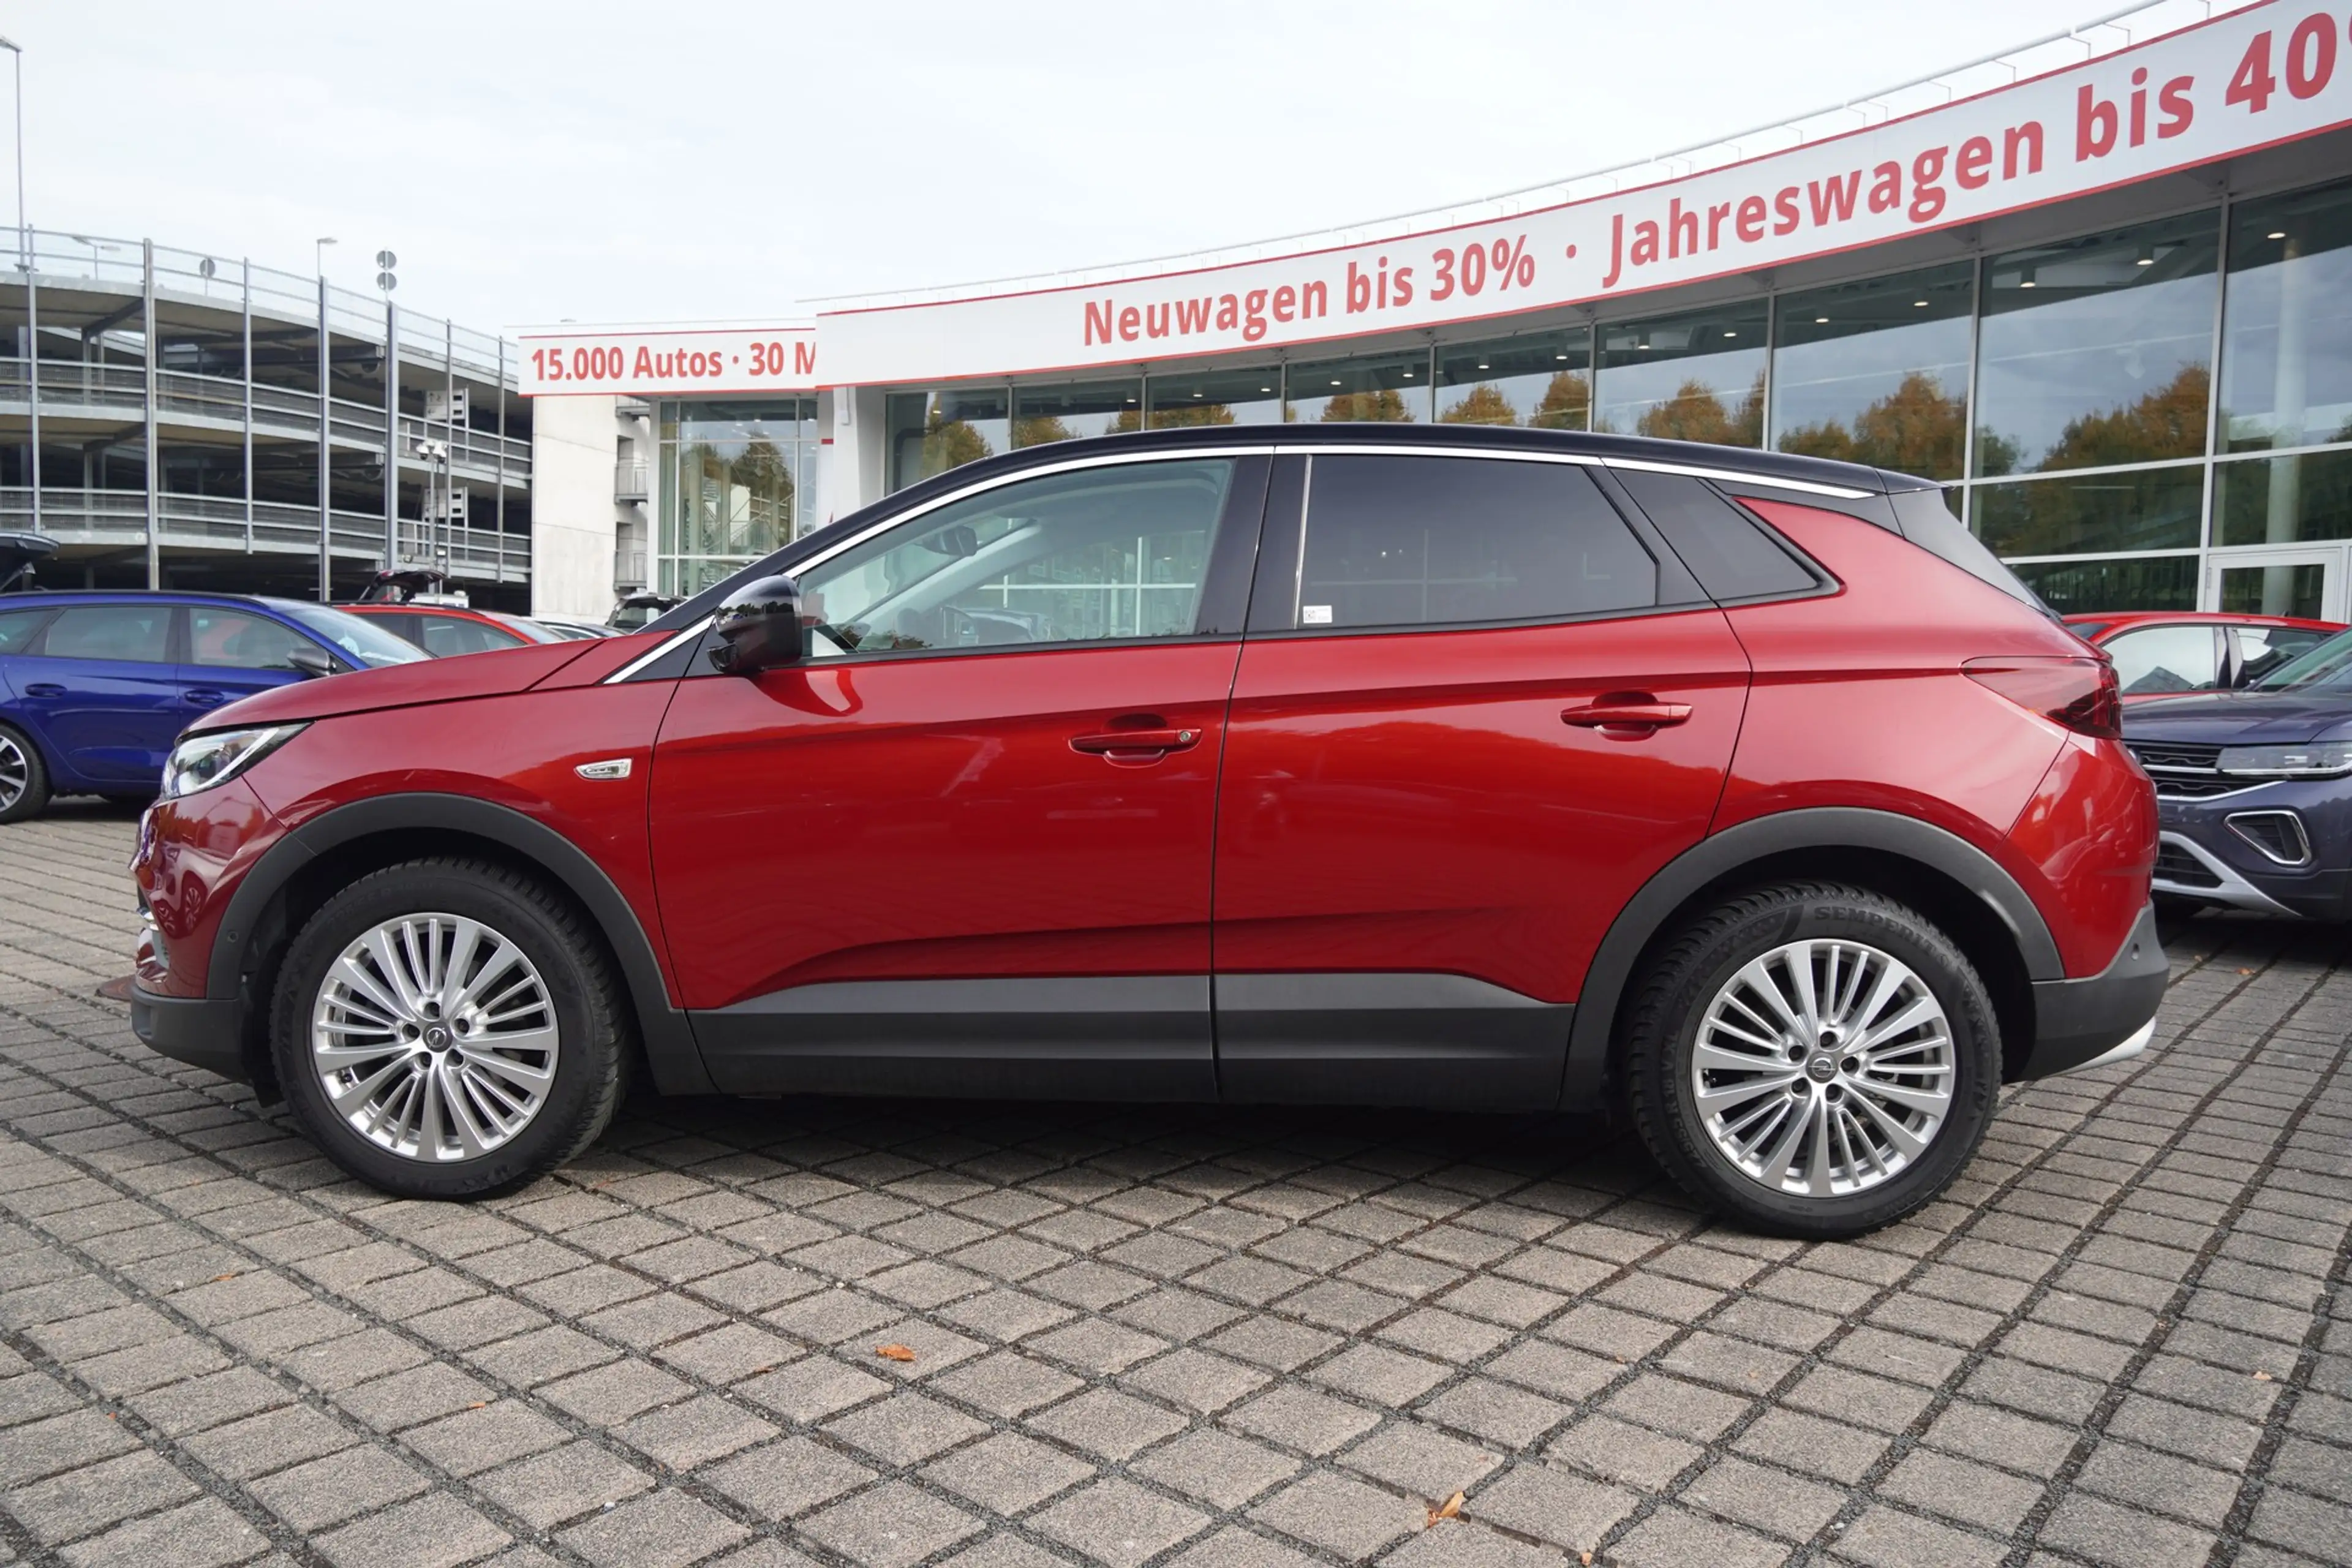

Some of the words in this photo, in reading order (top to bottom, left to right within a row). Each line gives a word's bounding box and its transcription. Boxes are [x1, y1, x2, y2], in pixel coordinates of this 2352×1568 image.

[1084, 281, 1327, 346] Neuwagen
[1347, 257, 1413, 314] bis
[1430, 235, 1535, 301] 30%
[1602, 120, 2043, 288] Jahreswagen
[2076, 67, 2195, 162] bis
[2225, 12, 2352, 113] 40
[532, 347, 624, 381] 15.000
[633, 345, 723, 379] Autos
[749, 342, 784, 376] 30
